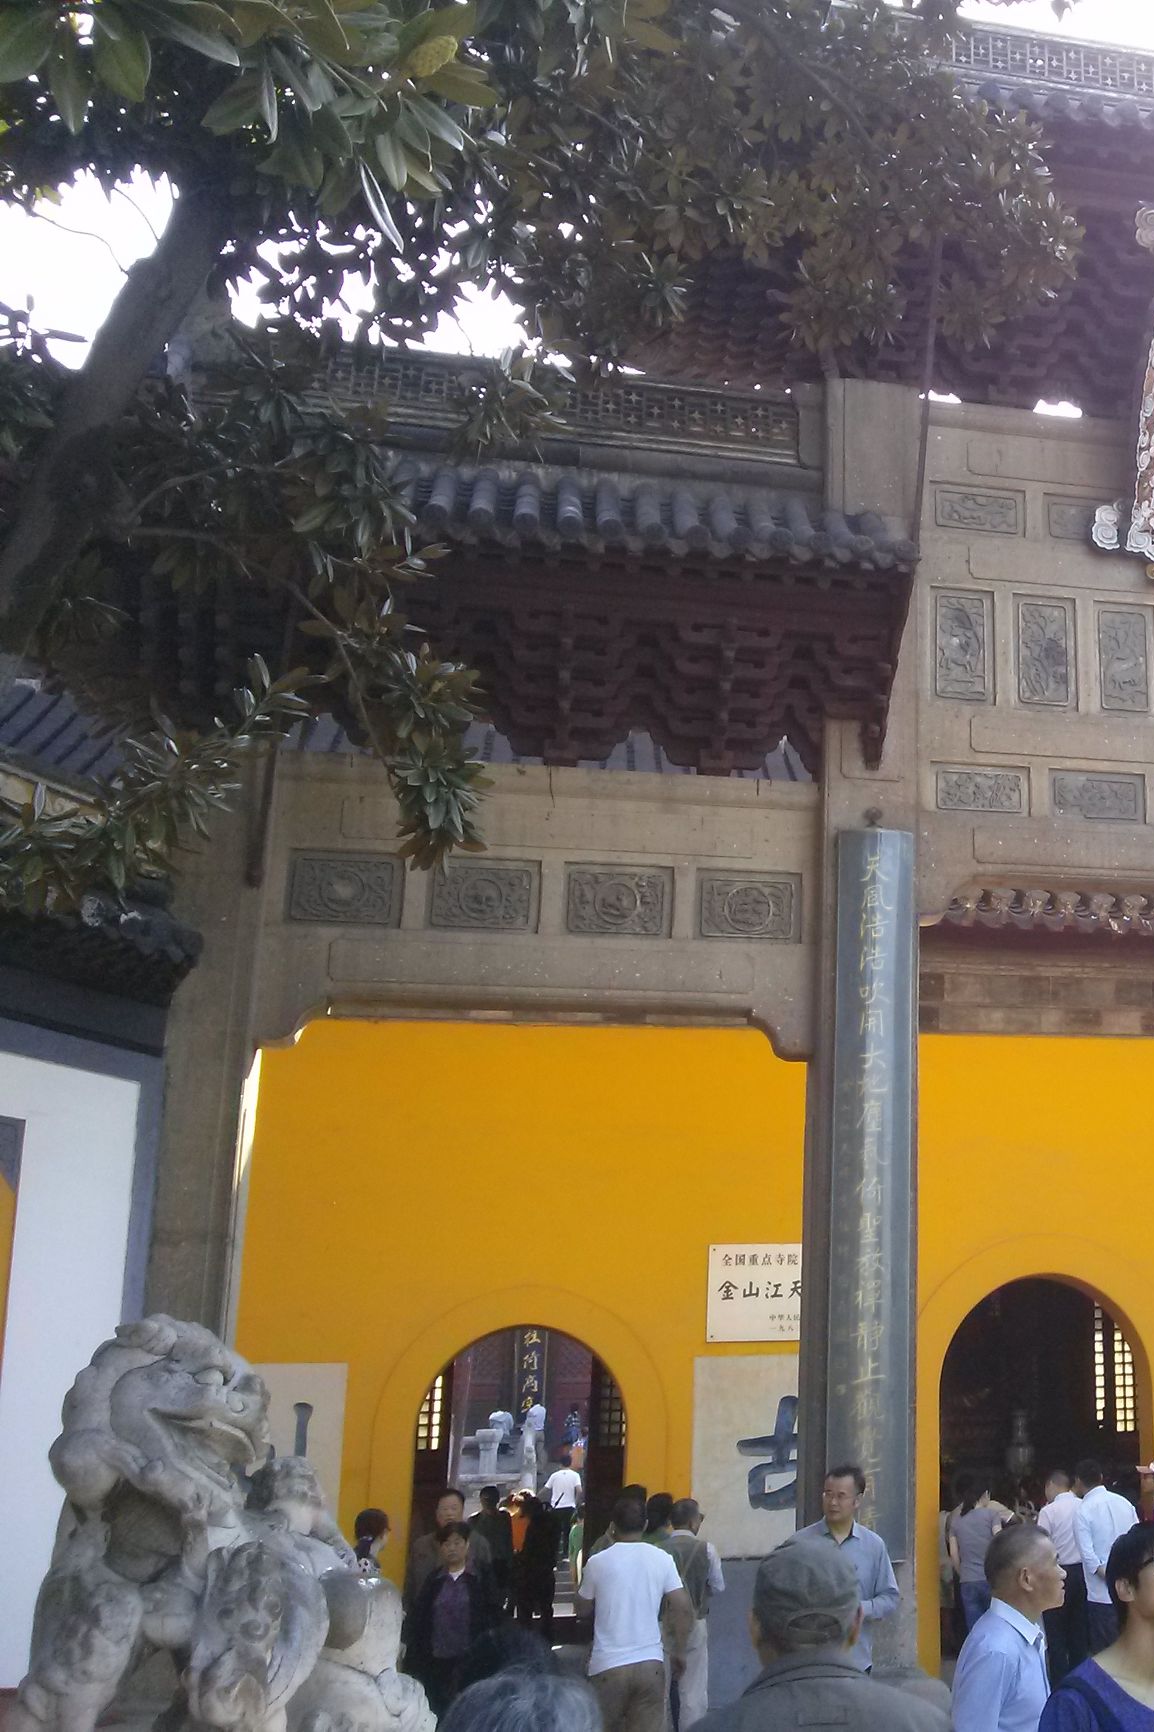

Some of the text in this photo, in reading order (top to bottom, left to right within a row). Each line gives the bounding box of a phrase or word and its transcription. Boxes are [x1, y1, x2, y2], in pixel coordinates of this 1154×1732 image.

[722, 1253, 799, 1266] 全国重点寺院
